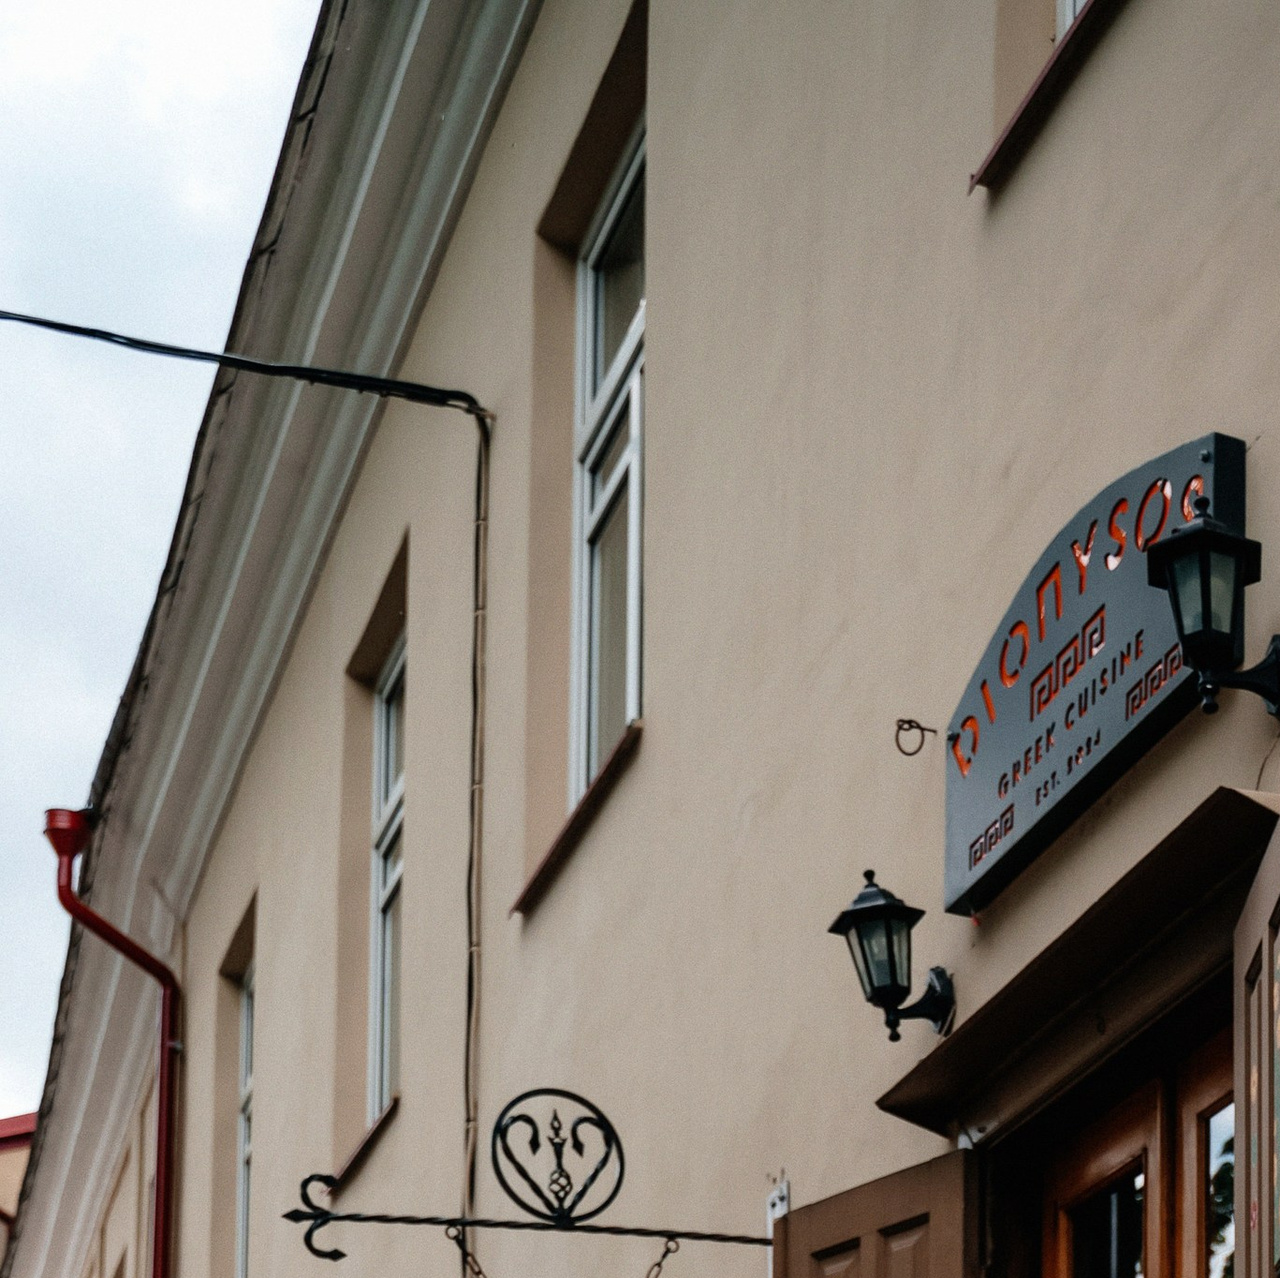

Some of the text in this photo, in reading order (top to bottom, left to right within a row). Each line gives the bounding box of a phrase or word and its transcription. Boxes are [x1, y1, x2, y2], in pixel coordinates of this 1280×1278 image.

[998, 629, 1145, 800] GREEK CUISINE
[1035, 771, 1060, 807] EST.
